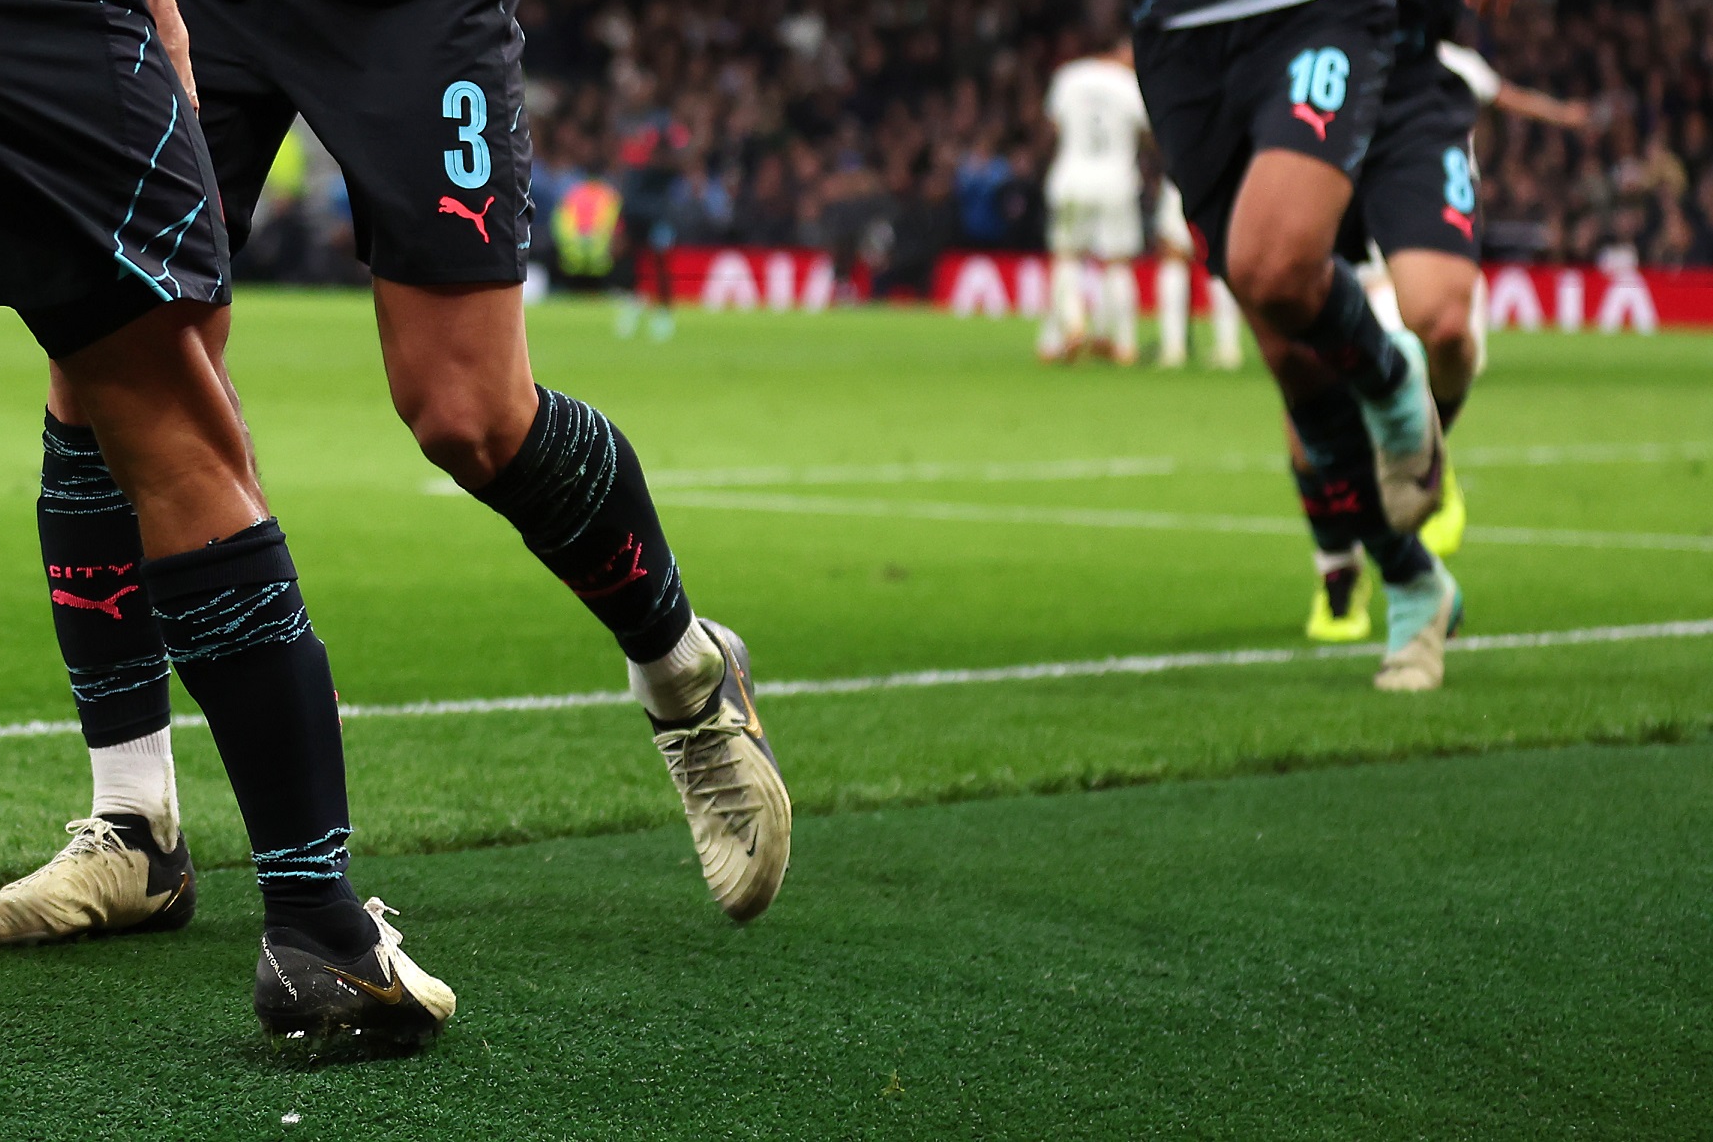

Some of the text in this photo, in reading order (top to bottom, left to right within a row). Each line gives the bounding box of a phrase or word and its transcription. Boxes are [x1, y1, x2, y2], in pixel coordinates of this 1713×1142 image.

[1288, 46, 1351, 112] 16
[442, 80, 492, 189] 3
[1442, 146, 1476, 214] 8
[1488, 264, 1662, 337] AIA
[49, 562, 134, 579] CITY
[277, 969, 299, 1002] LUNA
